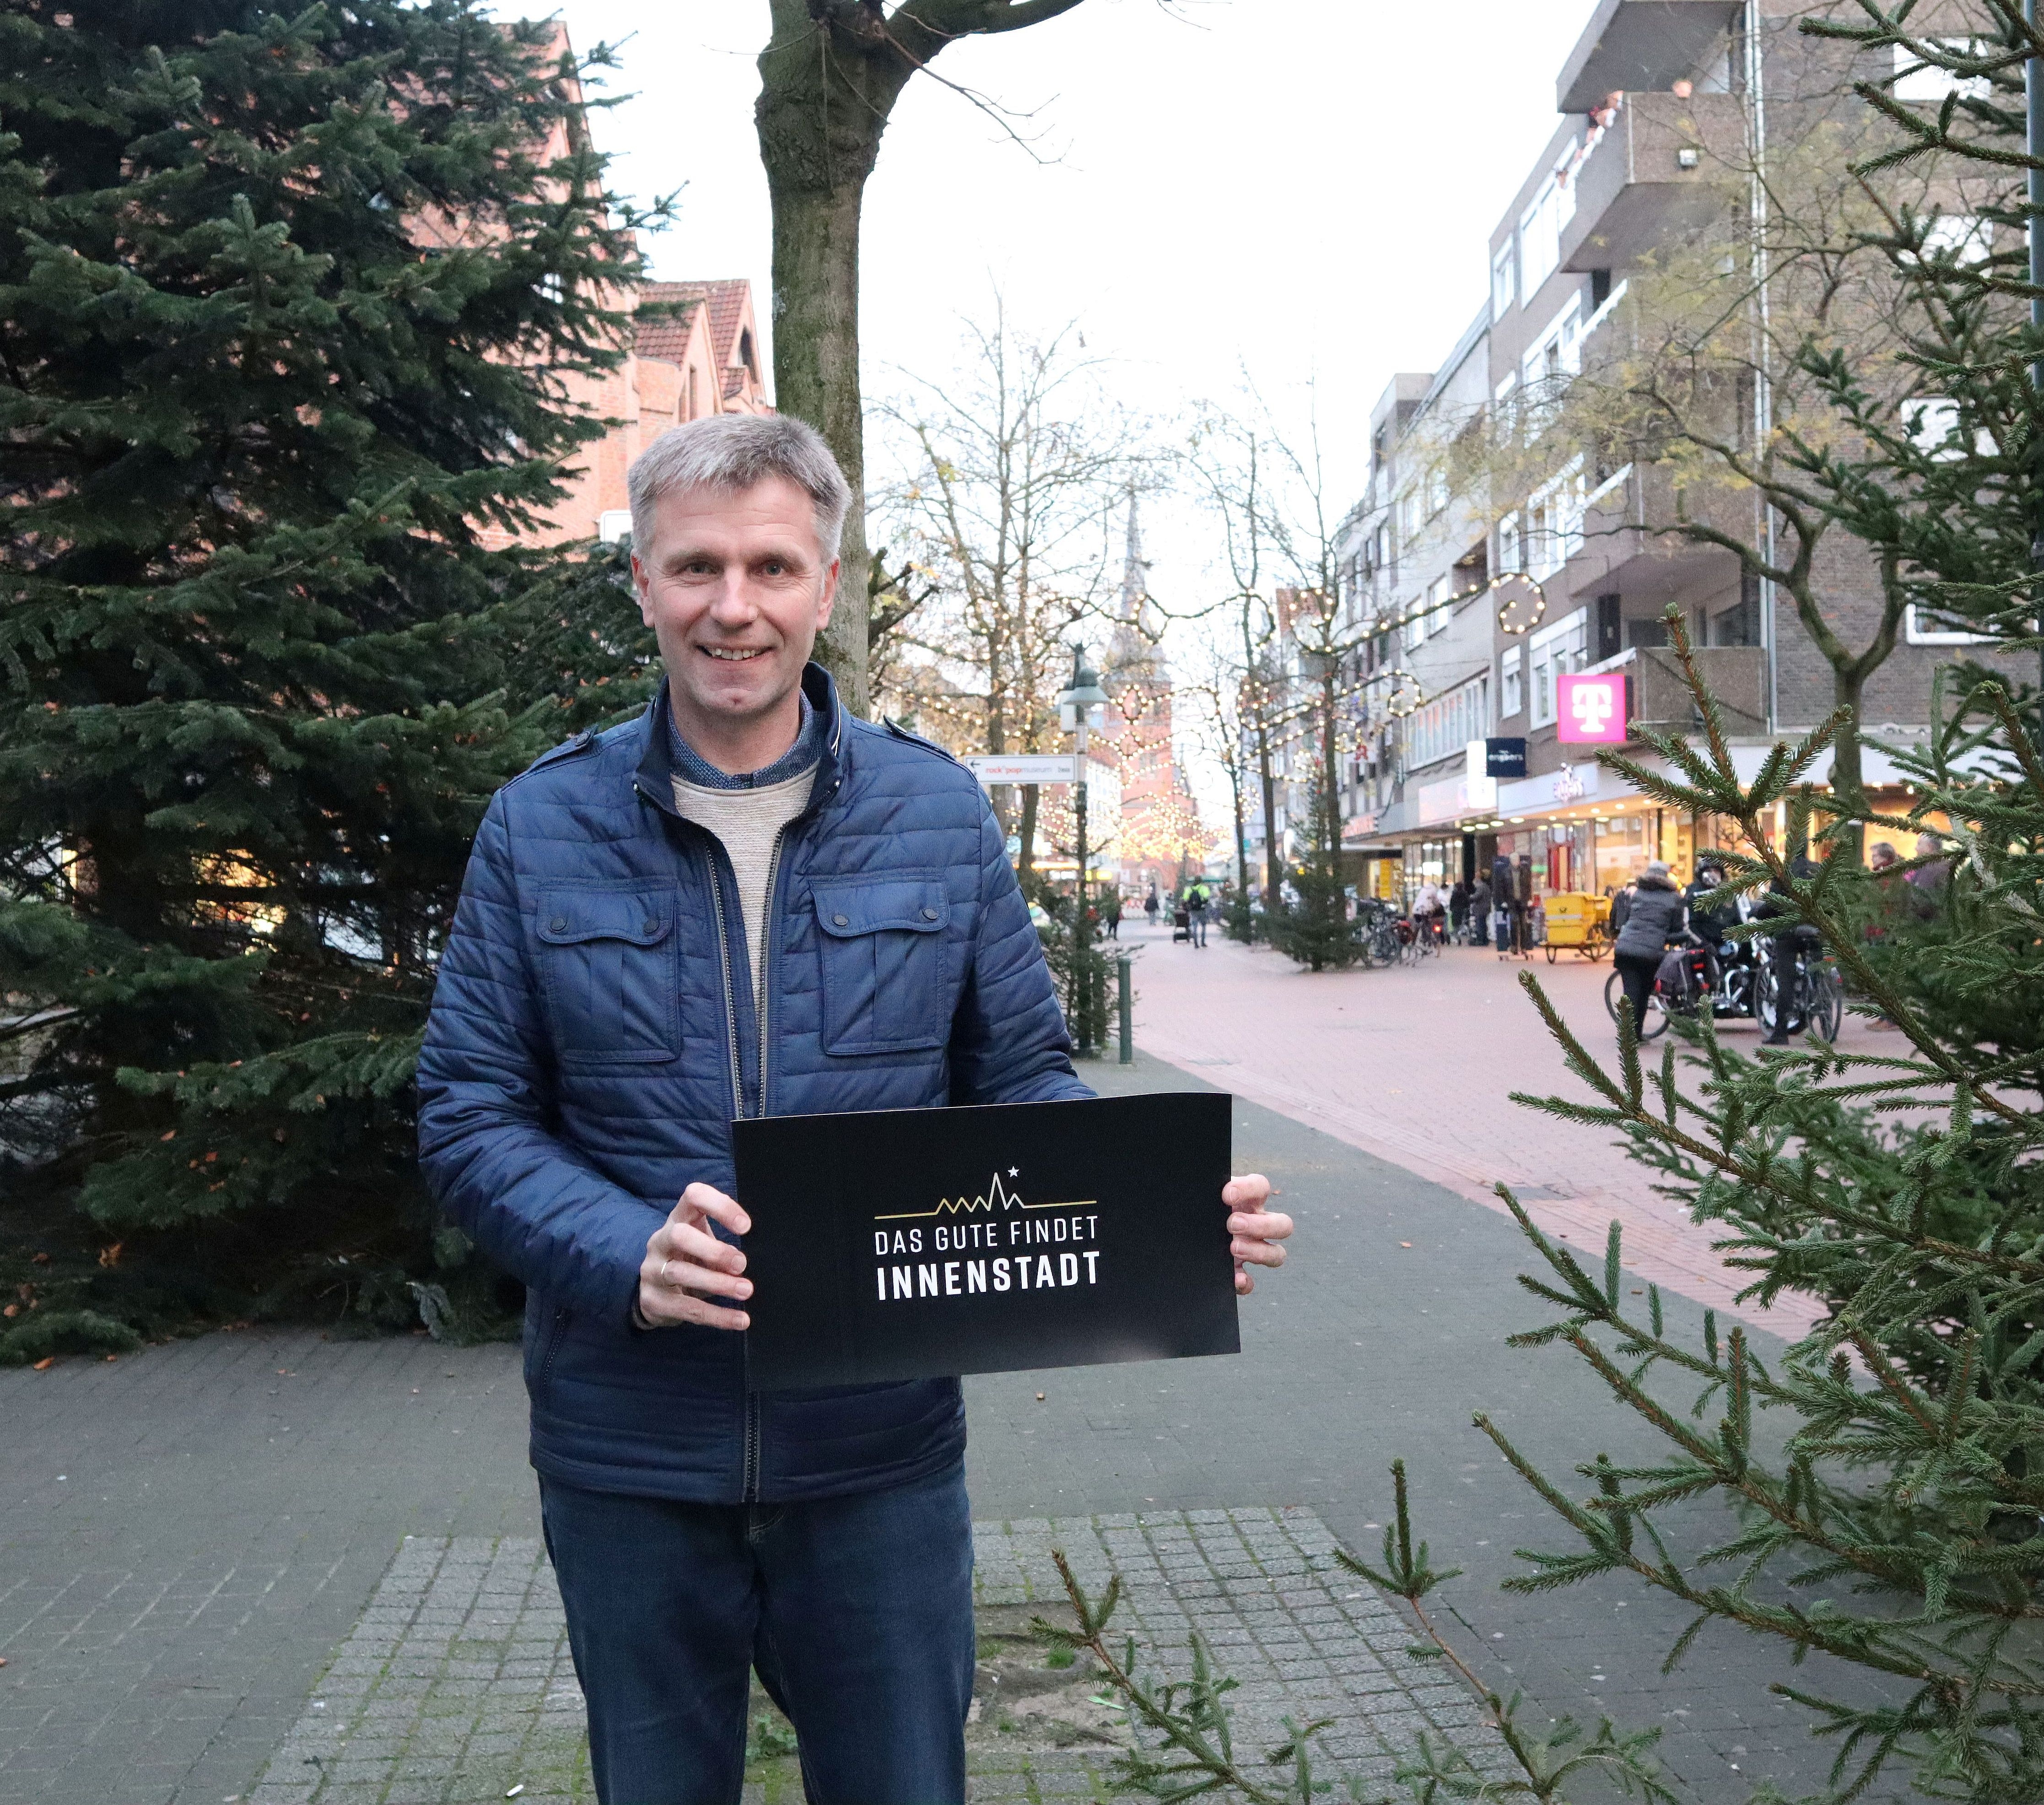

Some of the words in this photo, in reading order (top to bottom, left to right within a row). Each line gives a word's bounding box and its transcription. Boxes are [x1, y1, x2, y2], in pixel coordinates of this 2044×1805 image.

[875, 1228, 922, 1255] DAS
[935, 1223, 998, 1251] GUTE
[1010, 1215, 1098, 1245] FINDET
[877, 1251, 1100, 1301] INNENSTADT
